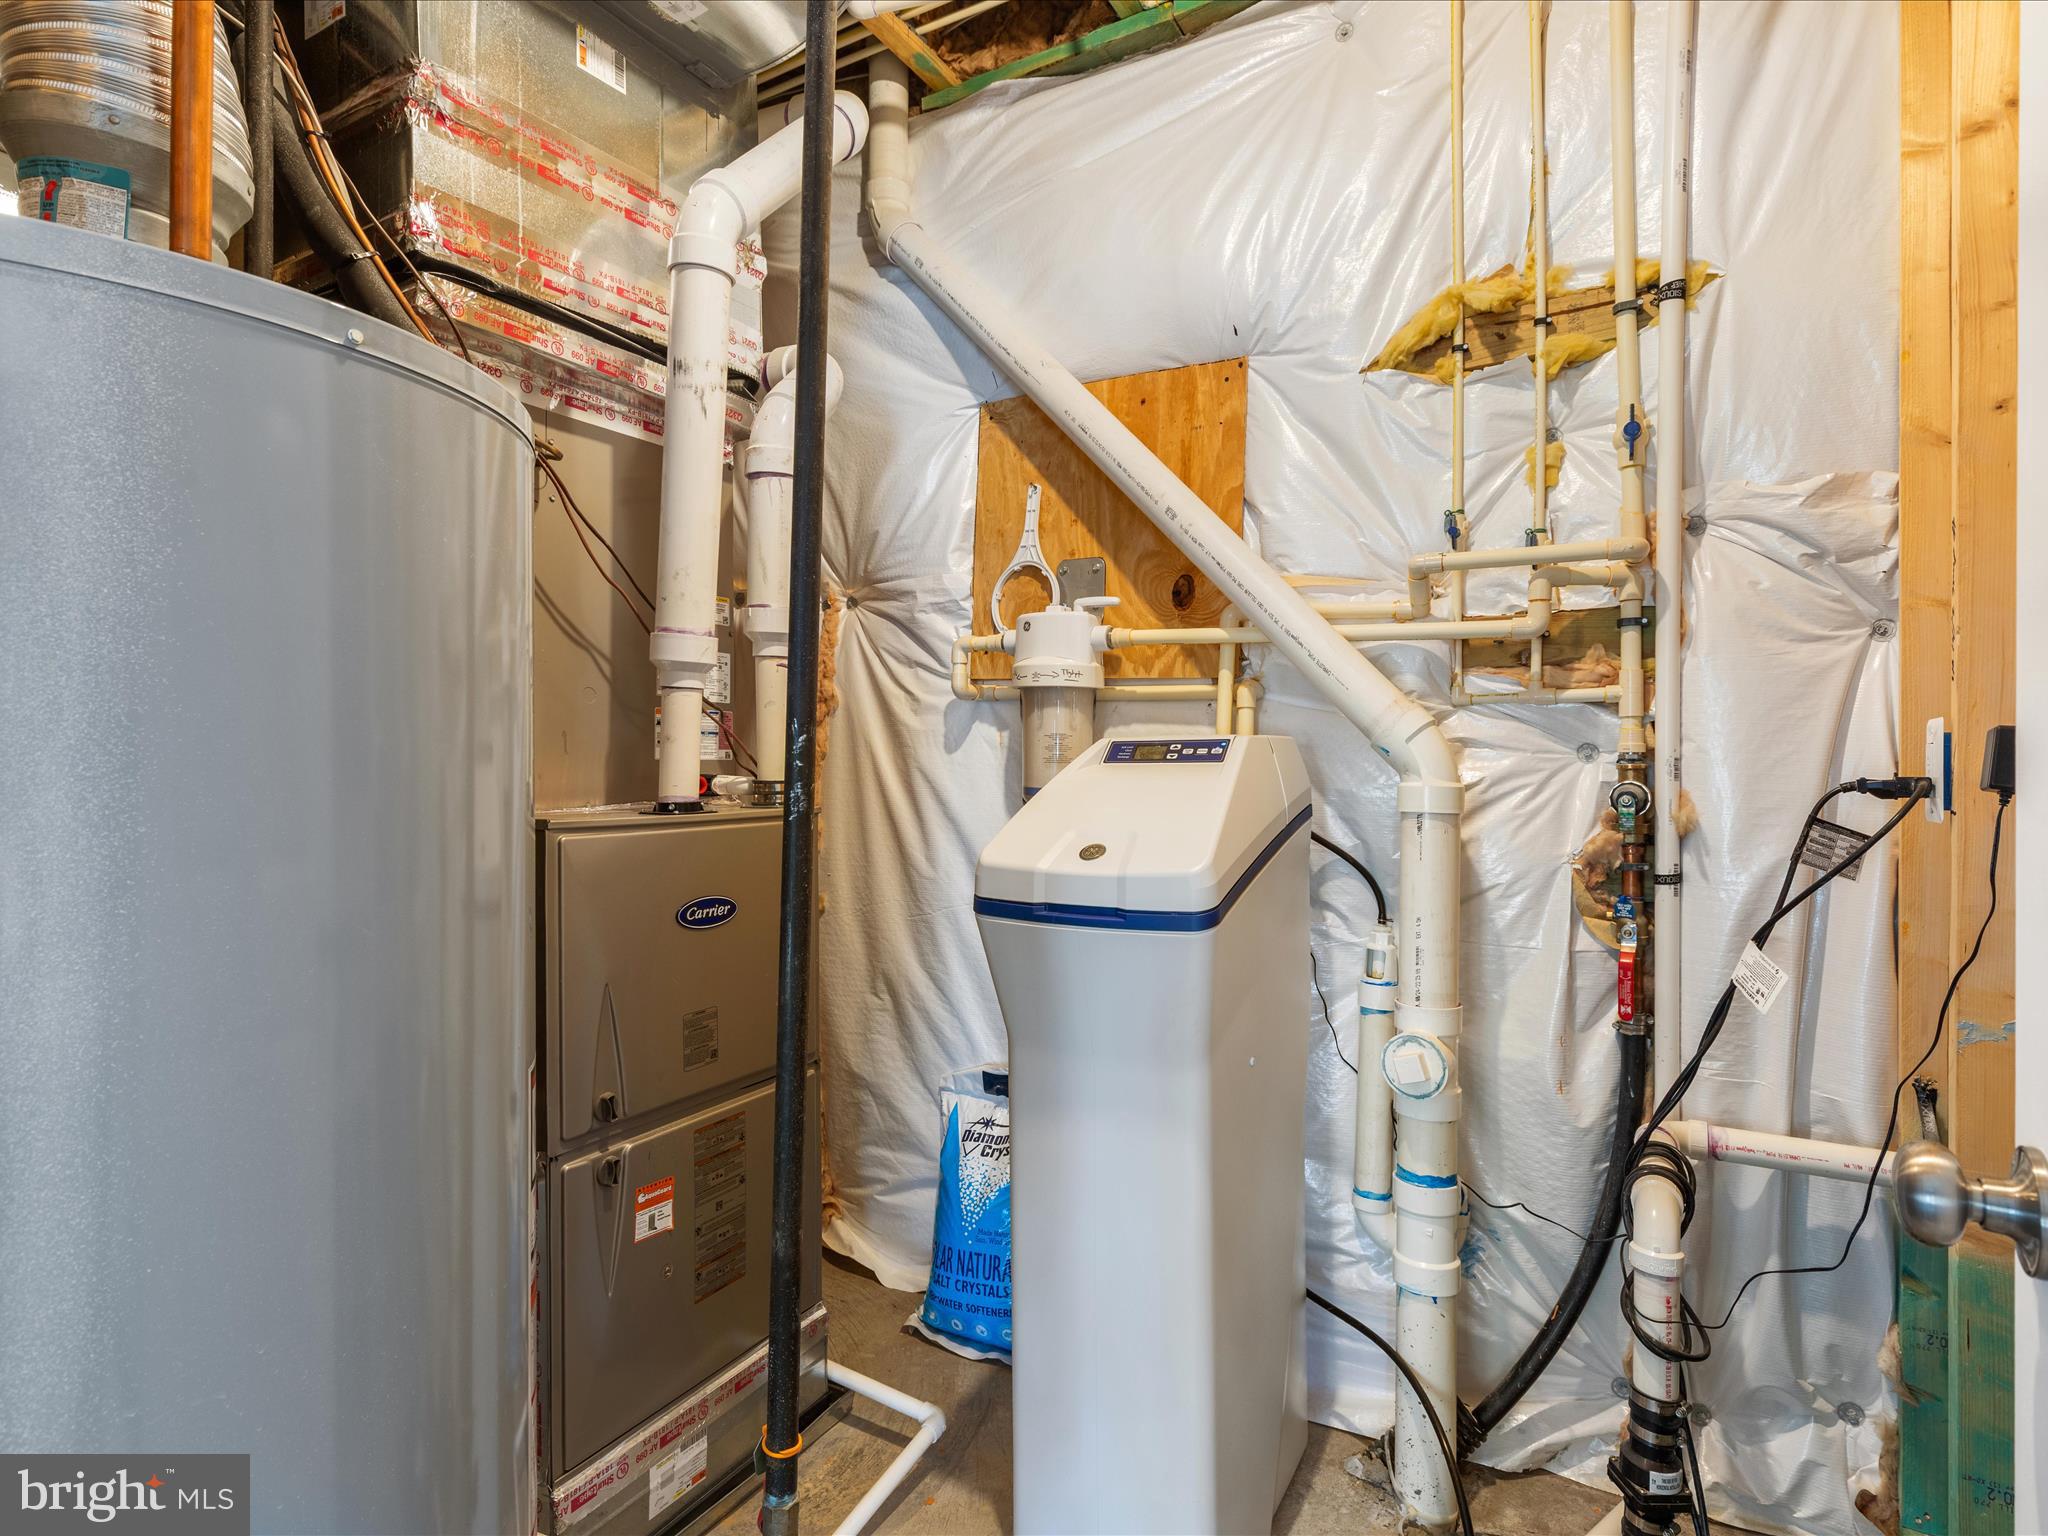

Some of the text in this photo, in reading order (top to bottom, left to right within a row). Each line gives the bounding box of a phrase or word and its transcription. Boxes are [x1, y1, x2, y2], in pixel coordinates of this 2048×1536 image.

[1658, 288, 1681, 300] SIOUX
[686, 903, 731, 921] Carrier
[955, 1279, 1011, 1299] CRYSTALS
